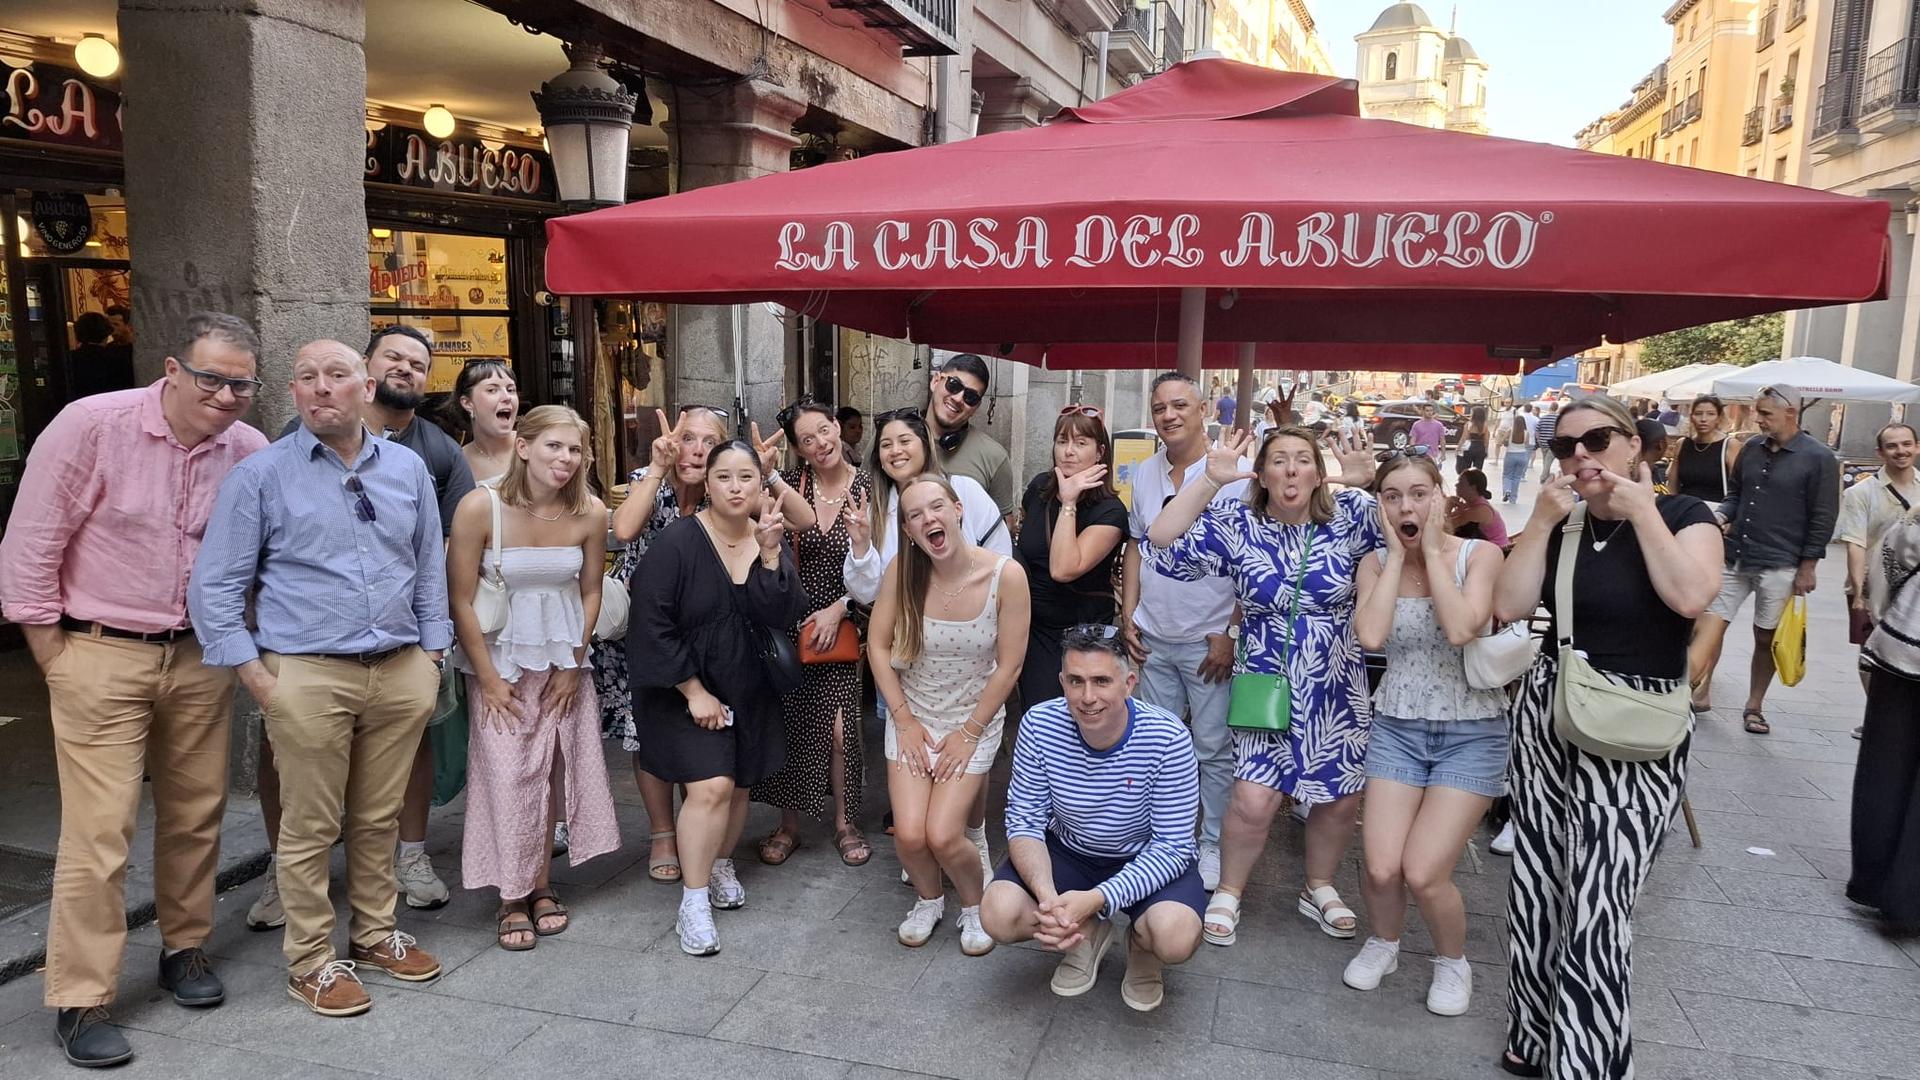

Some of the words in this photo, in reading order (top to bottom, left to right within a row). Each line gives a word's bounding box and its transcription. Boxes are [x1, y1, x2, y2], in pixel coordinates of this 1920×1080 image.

[2, 68, 98, 138] LA
[397, 134, 542, 194] ABUELO
[52, 225, 89, 250] GENEROSO
[774, 221, 860, 272] LA
[872, 214, 1054, 271] CASA
[1065, 212, 1204, 268] DEL
